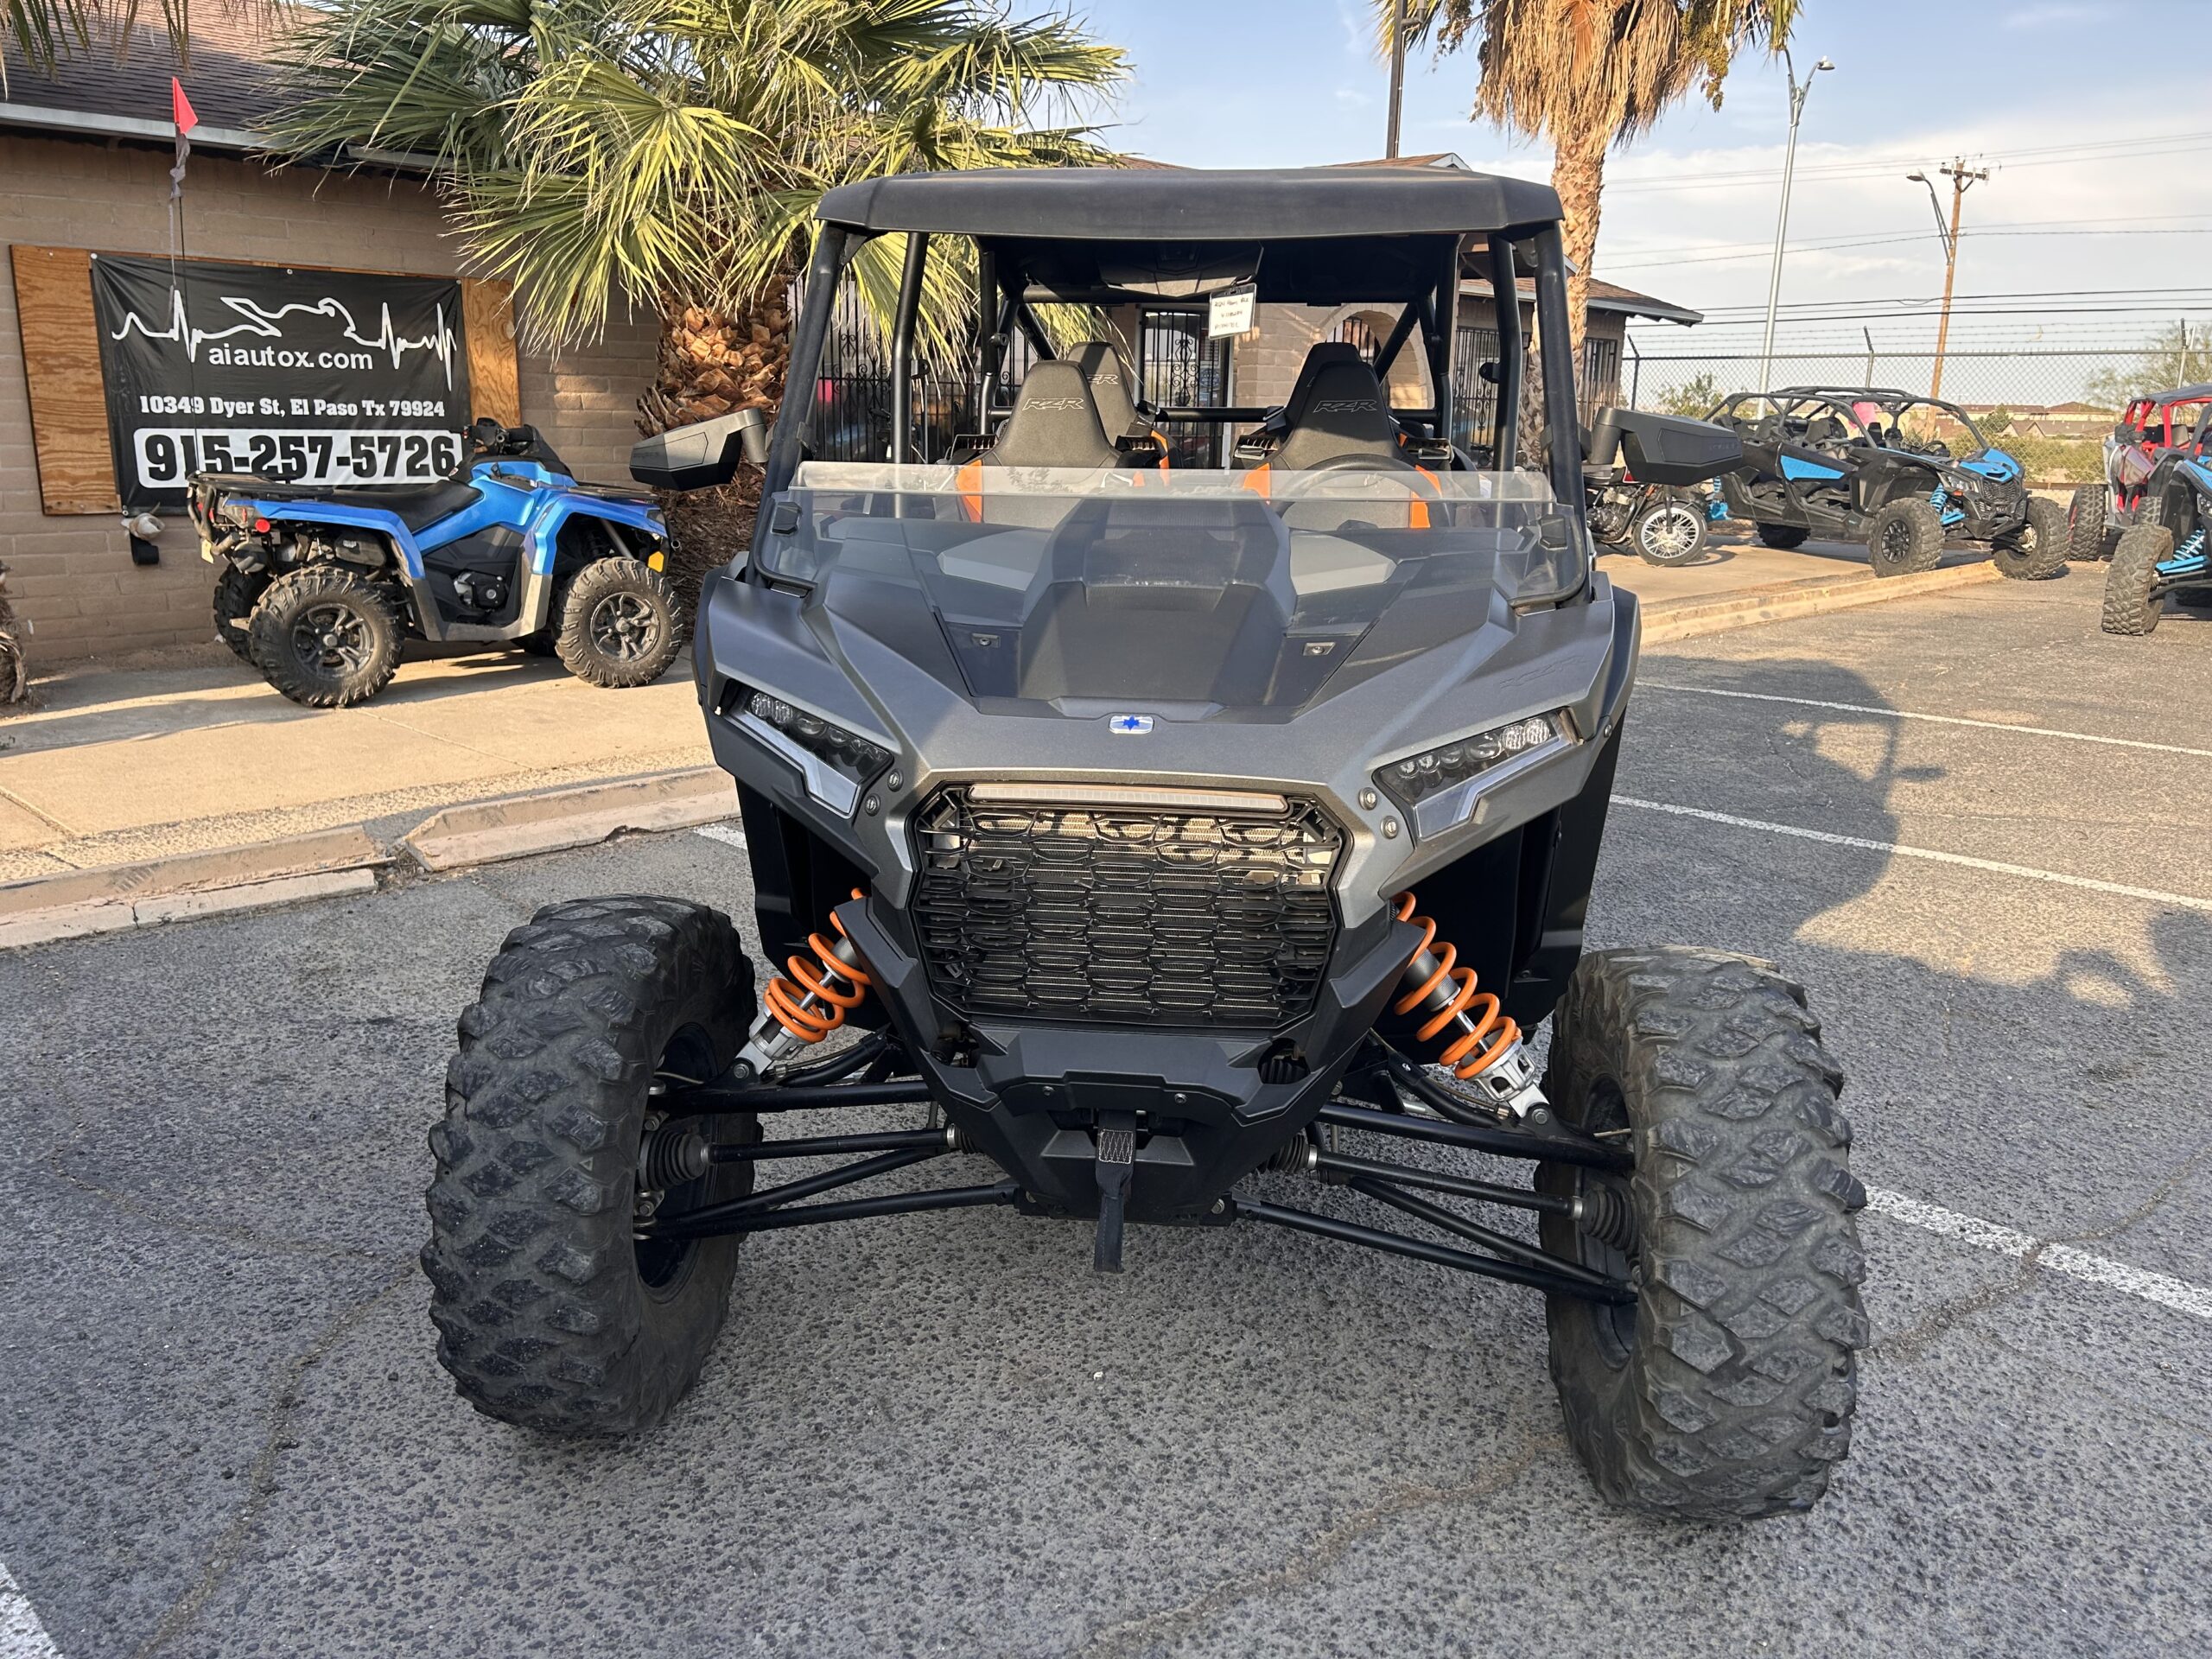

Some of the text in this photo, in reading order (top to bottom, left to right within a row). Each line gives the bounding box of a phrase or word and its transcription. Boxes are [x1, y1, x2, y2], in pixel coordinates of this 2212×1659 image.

[208, 343, 373, 369] aiautox.com
[139, 396, 445, 418] 10349 Dyer St, El Paso Tx 79924
[1022, 397, 1085, 411] RZR
[1313, 398, 1378, 413] RZR
[144, 434, 456, 481] 915-257-5726
